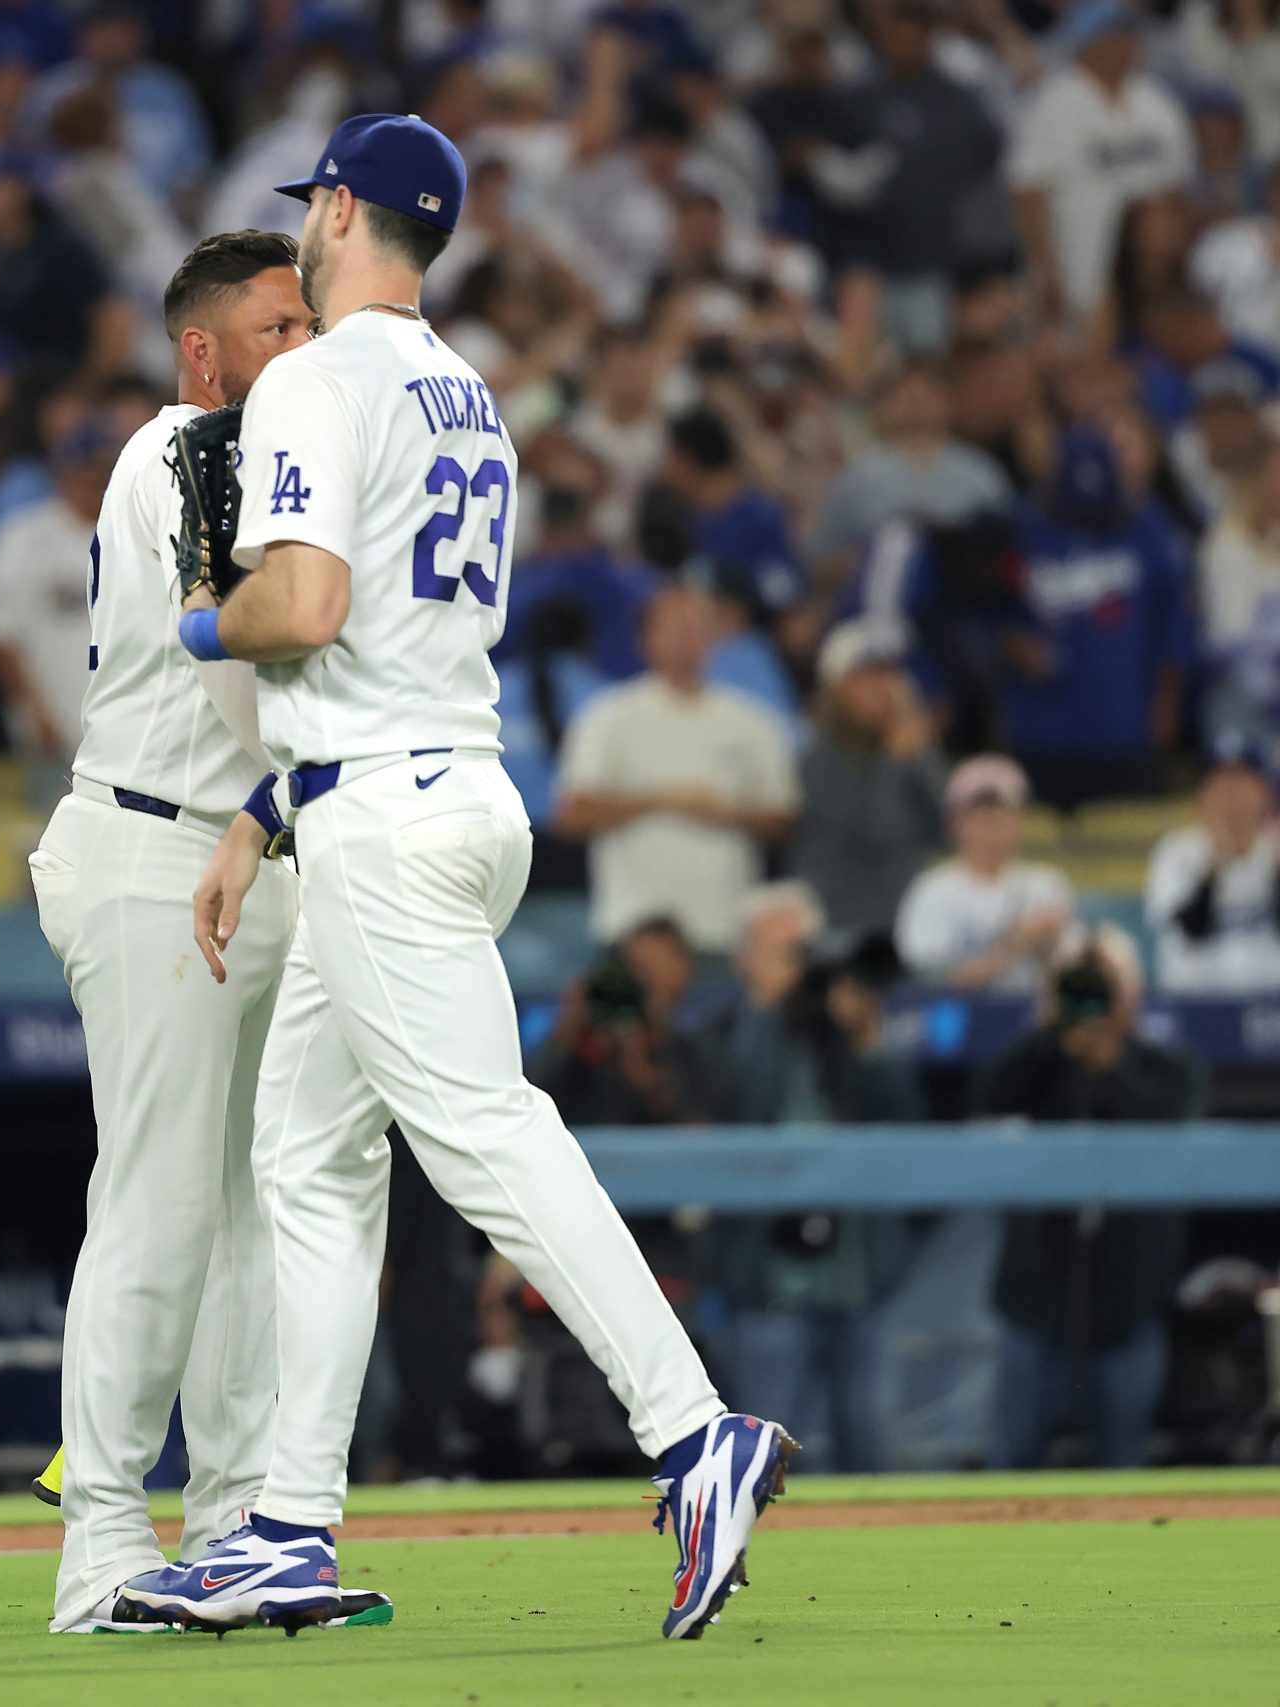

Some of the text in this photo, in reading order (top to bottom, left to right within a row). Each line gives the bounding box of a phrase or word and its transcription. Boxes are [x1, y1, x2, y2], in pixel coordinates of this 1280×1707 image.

[405, 375, 503, 442] TUCKE
[271, 451, 311, 515] LA
[413, 455, 509, 608] 23
